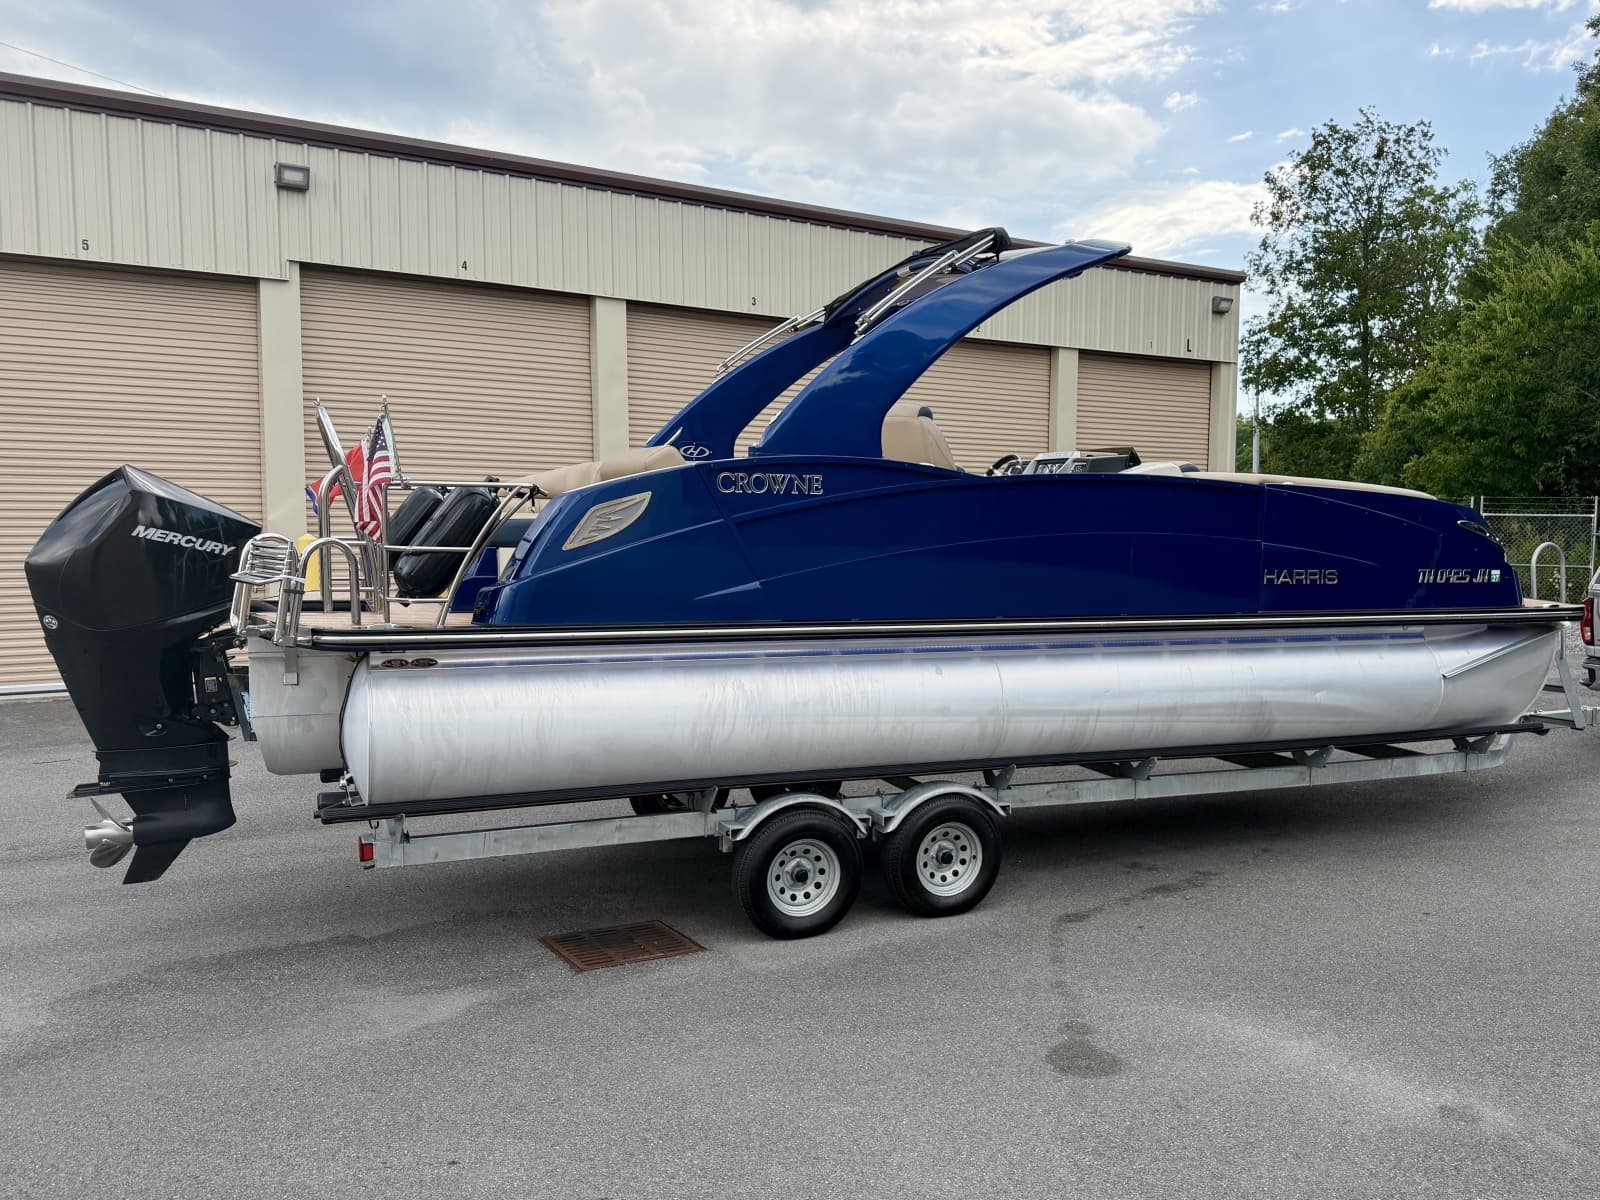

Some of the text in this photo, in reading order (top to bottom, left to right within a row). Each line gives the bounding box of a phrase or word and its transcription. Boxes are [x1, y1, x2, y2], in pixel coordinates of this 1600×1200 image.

[81, 239, 89, 251] 5
[461, 260, 467, 271] 4
[751, 296, 757, 306] 3
[1186, 338, 1192, 353] L
[716, 471, 824, 495] CROWNE
[130, 524, 237, 556] MERCURY
[1263, 569, 1339, 585] HARRIS
